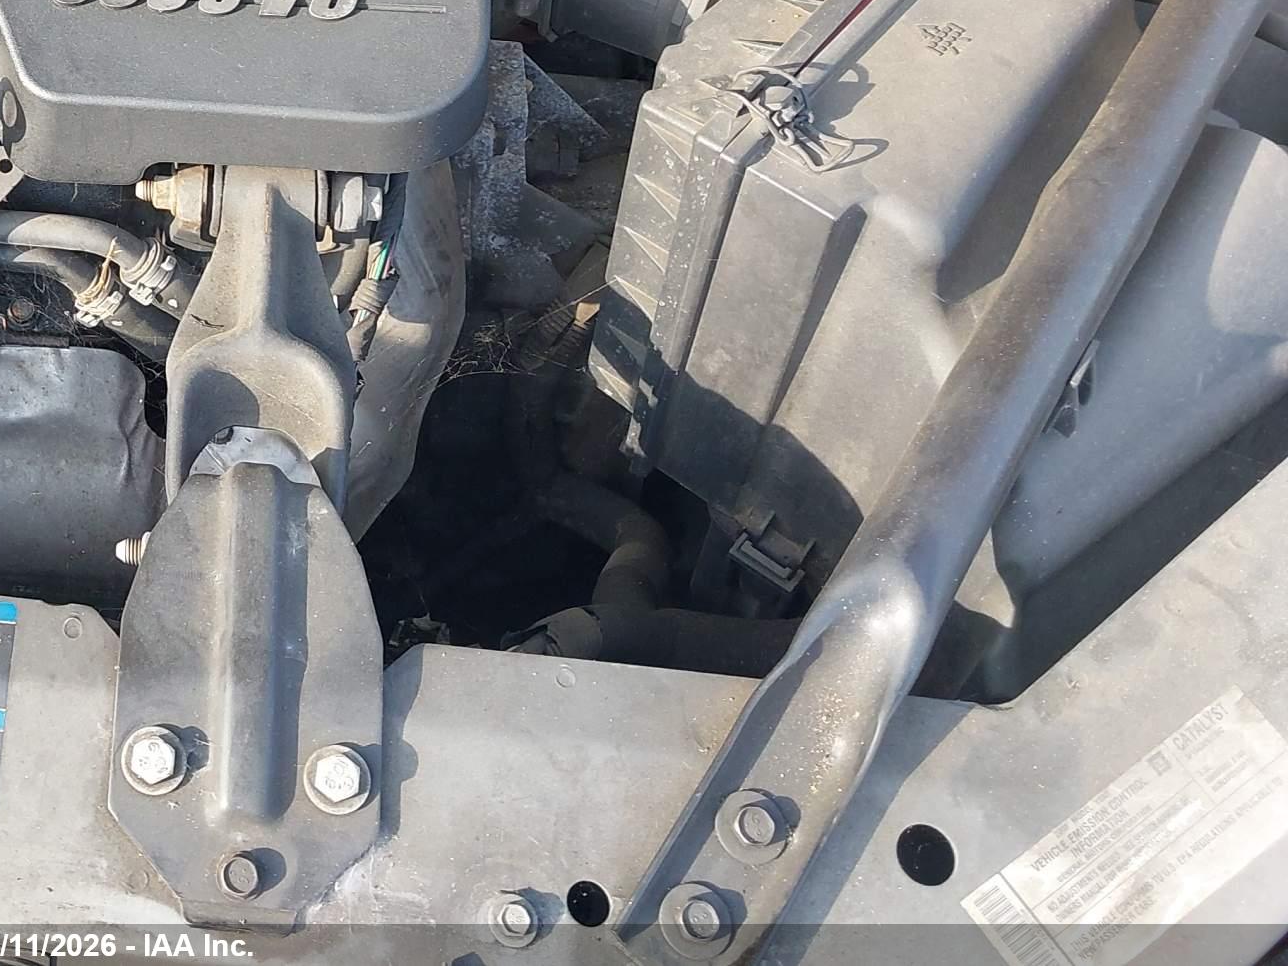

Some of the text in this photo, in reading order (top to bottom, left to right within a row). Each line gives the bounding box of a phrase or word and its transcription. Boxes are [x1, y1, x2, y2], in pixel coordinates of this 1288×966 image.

[1171, 701, 1230, 752] CATALYST
[1029, 776, 1148, 872] VEHICLE EMISSION CONTROL
[1068, 807, 1130, 858] INFORMATION
